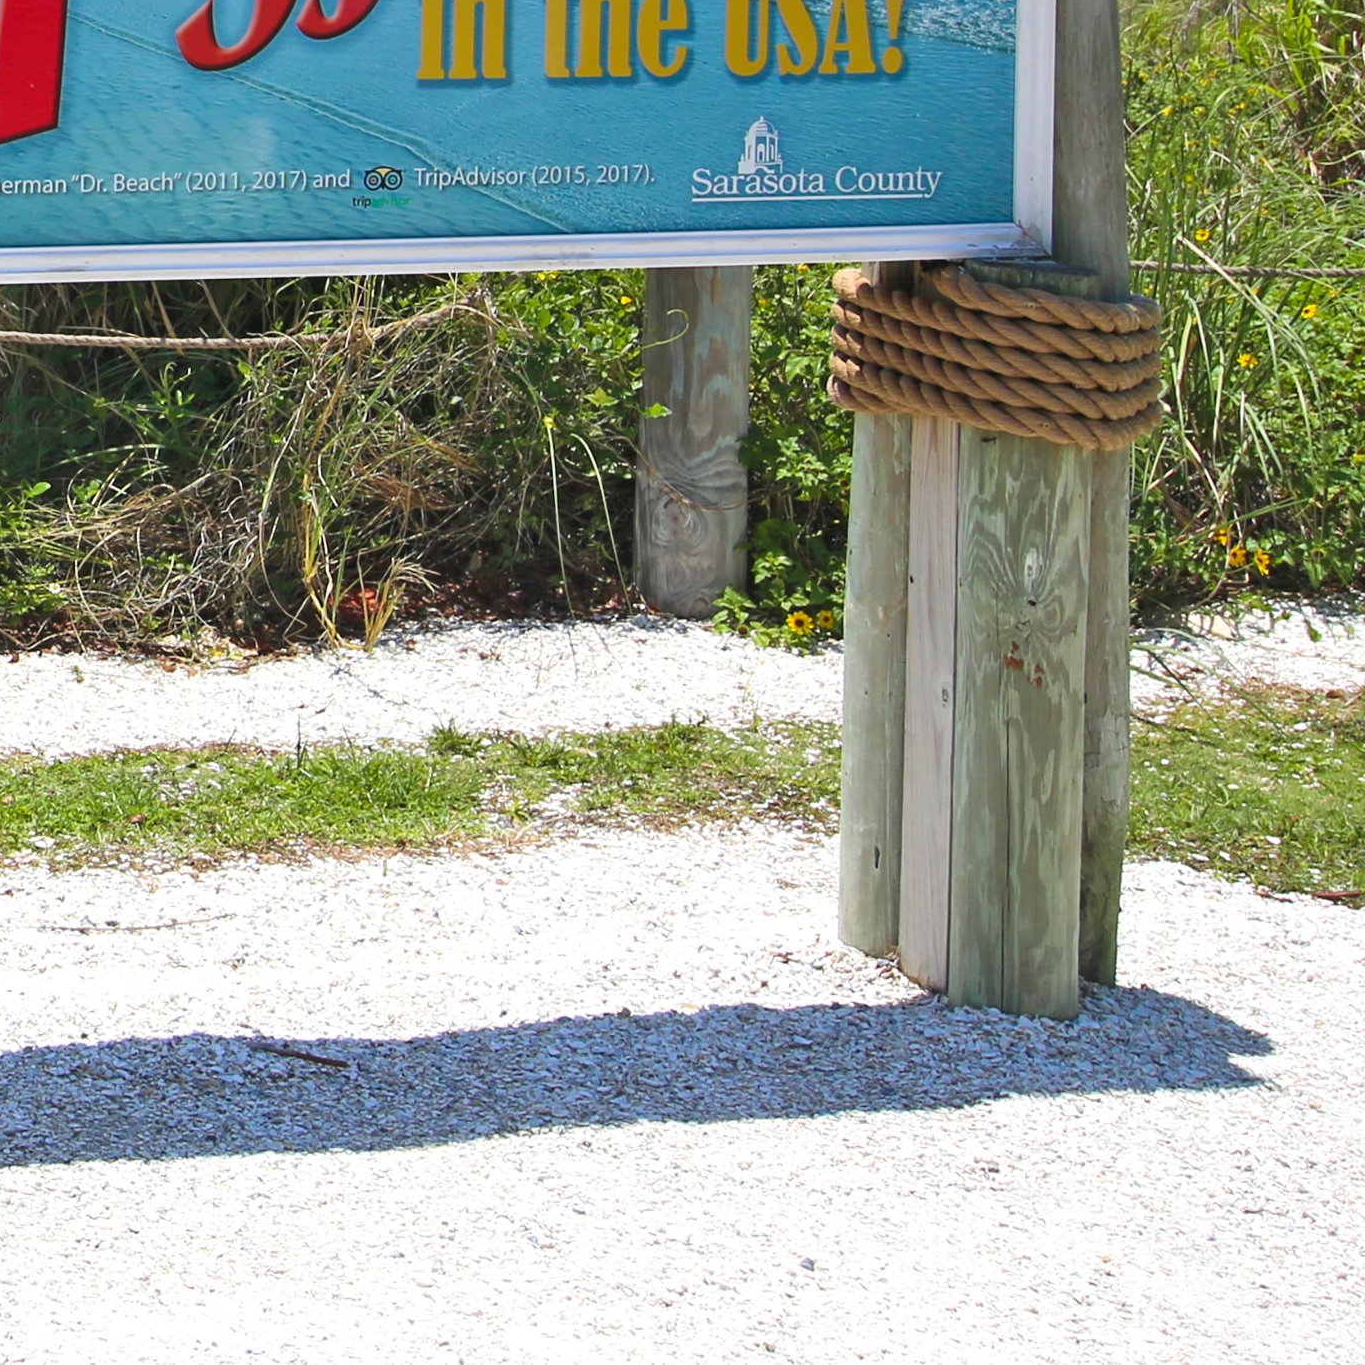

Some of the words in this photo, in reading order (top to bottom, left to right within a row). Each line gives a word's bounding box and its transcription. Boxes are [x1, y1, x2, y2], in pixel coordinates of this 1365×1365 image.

[185, 170, 245, 193] (2011,
[252, 169, 307, 192] 2017)
[313, 168, 351, 189] and
[414, 166, 526, 190] TripAdvisor
[531, 164, 591, 186] (2015,
[596, 163, 655, 185] 2017).
[691, 167, 826, 196] Sarasota
[835, 165, 943, 198] County
